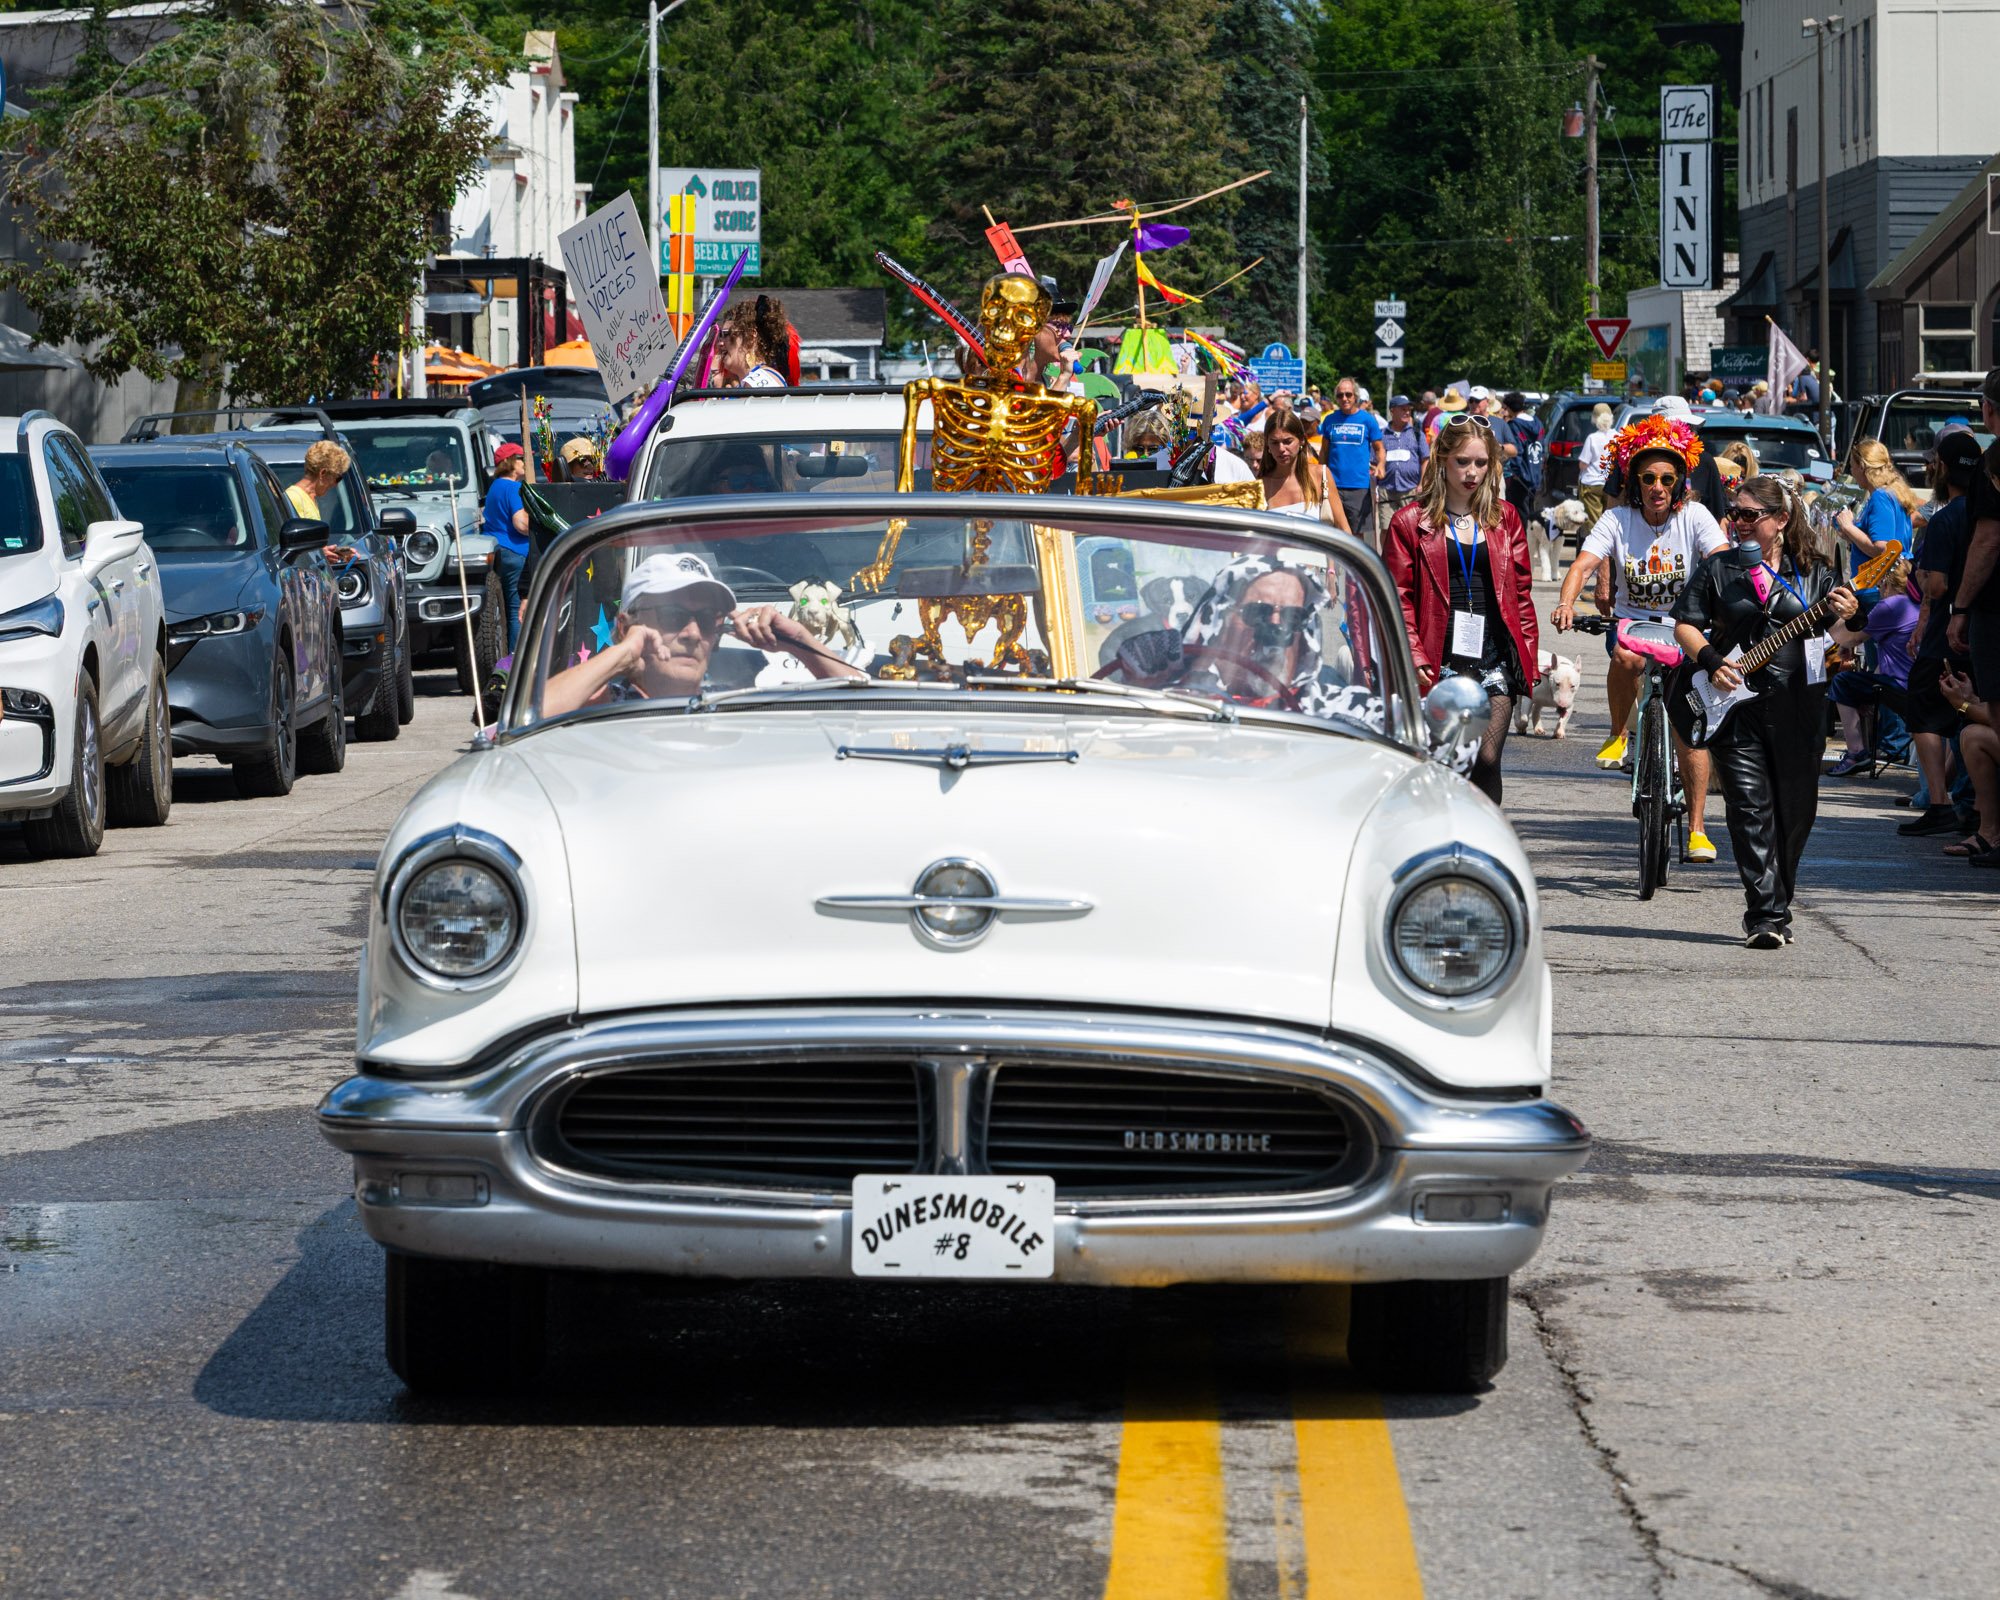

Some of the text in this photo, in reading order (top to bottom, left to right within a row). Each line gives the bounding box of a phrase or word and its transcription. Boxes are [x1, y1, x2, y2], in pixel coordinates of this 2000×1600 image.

[1667, 103, 1706, 128] The
[712, 180, 757, 201] CORNER
[714, 210, 756, 232] STORE
[1672, 151, 1699, 277] INN
[565, 211, 636, 295] VILLAGE
[695, 243, 719, 260] BEER
[721, 243, 728, 260] &
[587, 265, 636, 323] VOICES
[1377, 304, 1403, 314] NORTH
[596, 309, 624, 368] WE WILL
[1381, 329, 1397, 339] 201
[1714, 353, 1765, 371] Northport
[1723, 377, 1749, 385] CHECK
[1625, 571, 1686, 583] NORTHPORT
[1627, 578, 1685, 597] DOG
[1124, 1131, 1271, 1152] OLDSMOBILE
[861, 1193, 1045, 1256] DUNESMOBILE
[934, 1232, 971, 1260] #8
